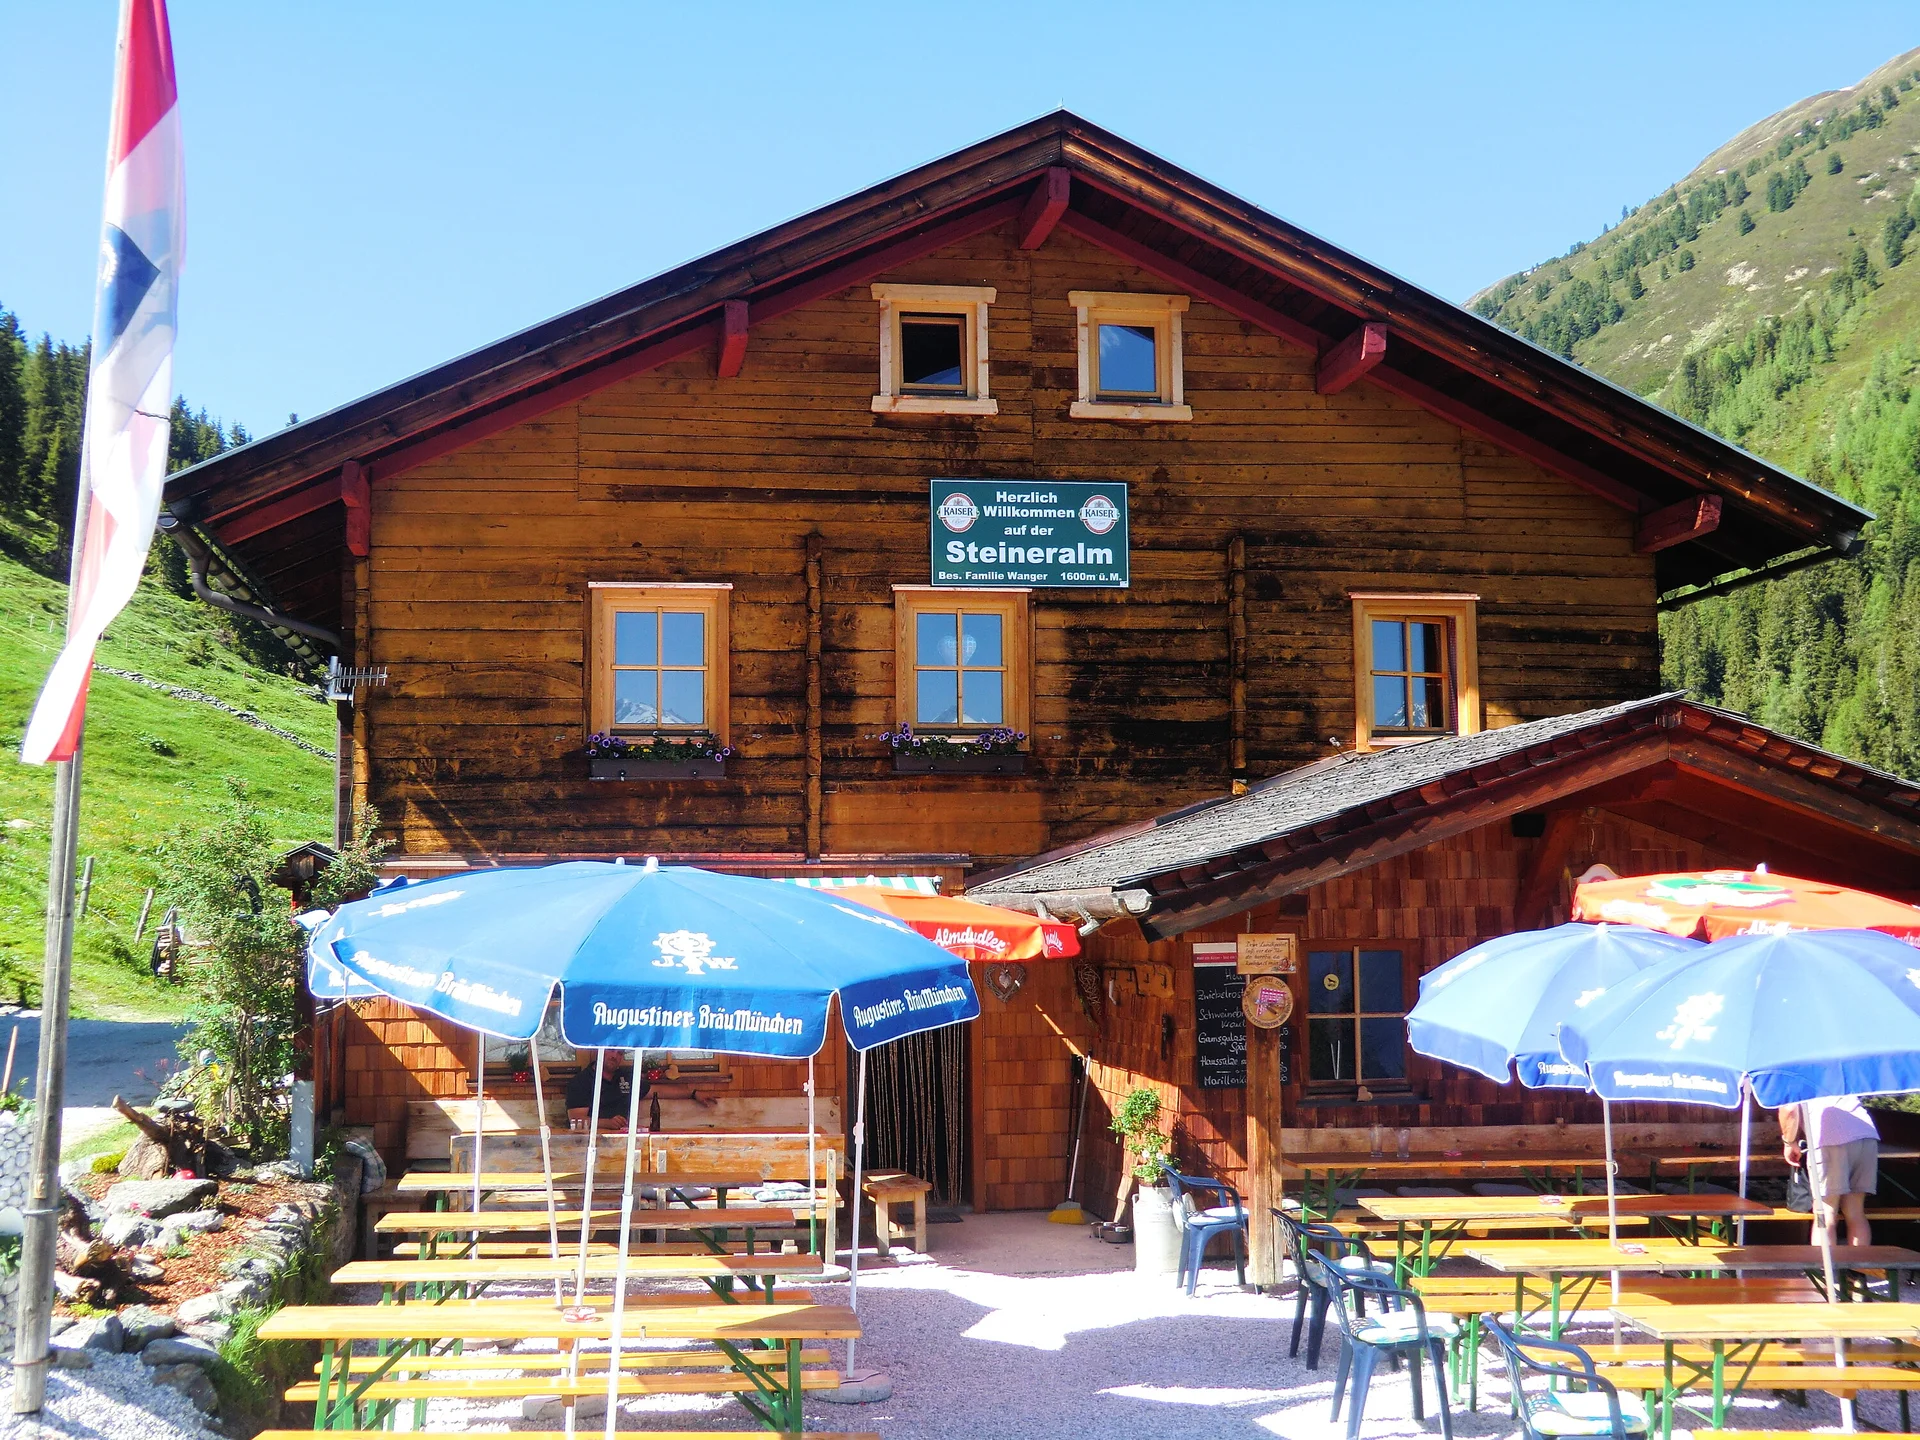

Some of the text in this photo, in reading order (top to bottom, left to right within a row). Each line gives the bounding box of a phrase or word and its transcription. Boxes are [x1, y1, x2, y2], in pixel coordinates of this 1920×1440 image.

[996, 491, 1058, 503] Herzlich
[943, 507, 973, 516] KAISER
[983, 506, 1075, 518] Willkommen
[1085, 509, 1114, 518] KAISER
[1004, 525, 1054, 536] auf der
[946, 540, 1113, 564] Steineralm
[938, 571, 962, 580] Bes.
[965, 571, 1005, 581] Familie
[1007, 572, 1048, 583] Wanger
[932, 925, 1006, 951] Almdudler
